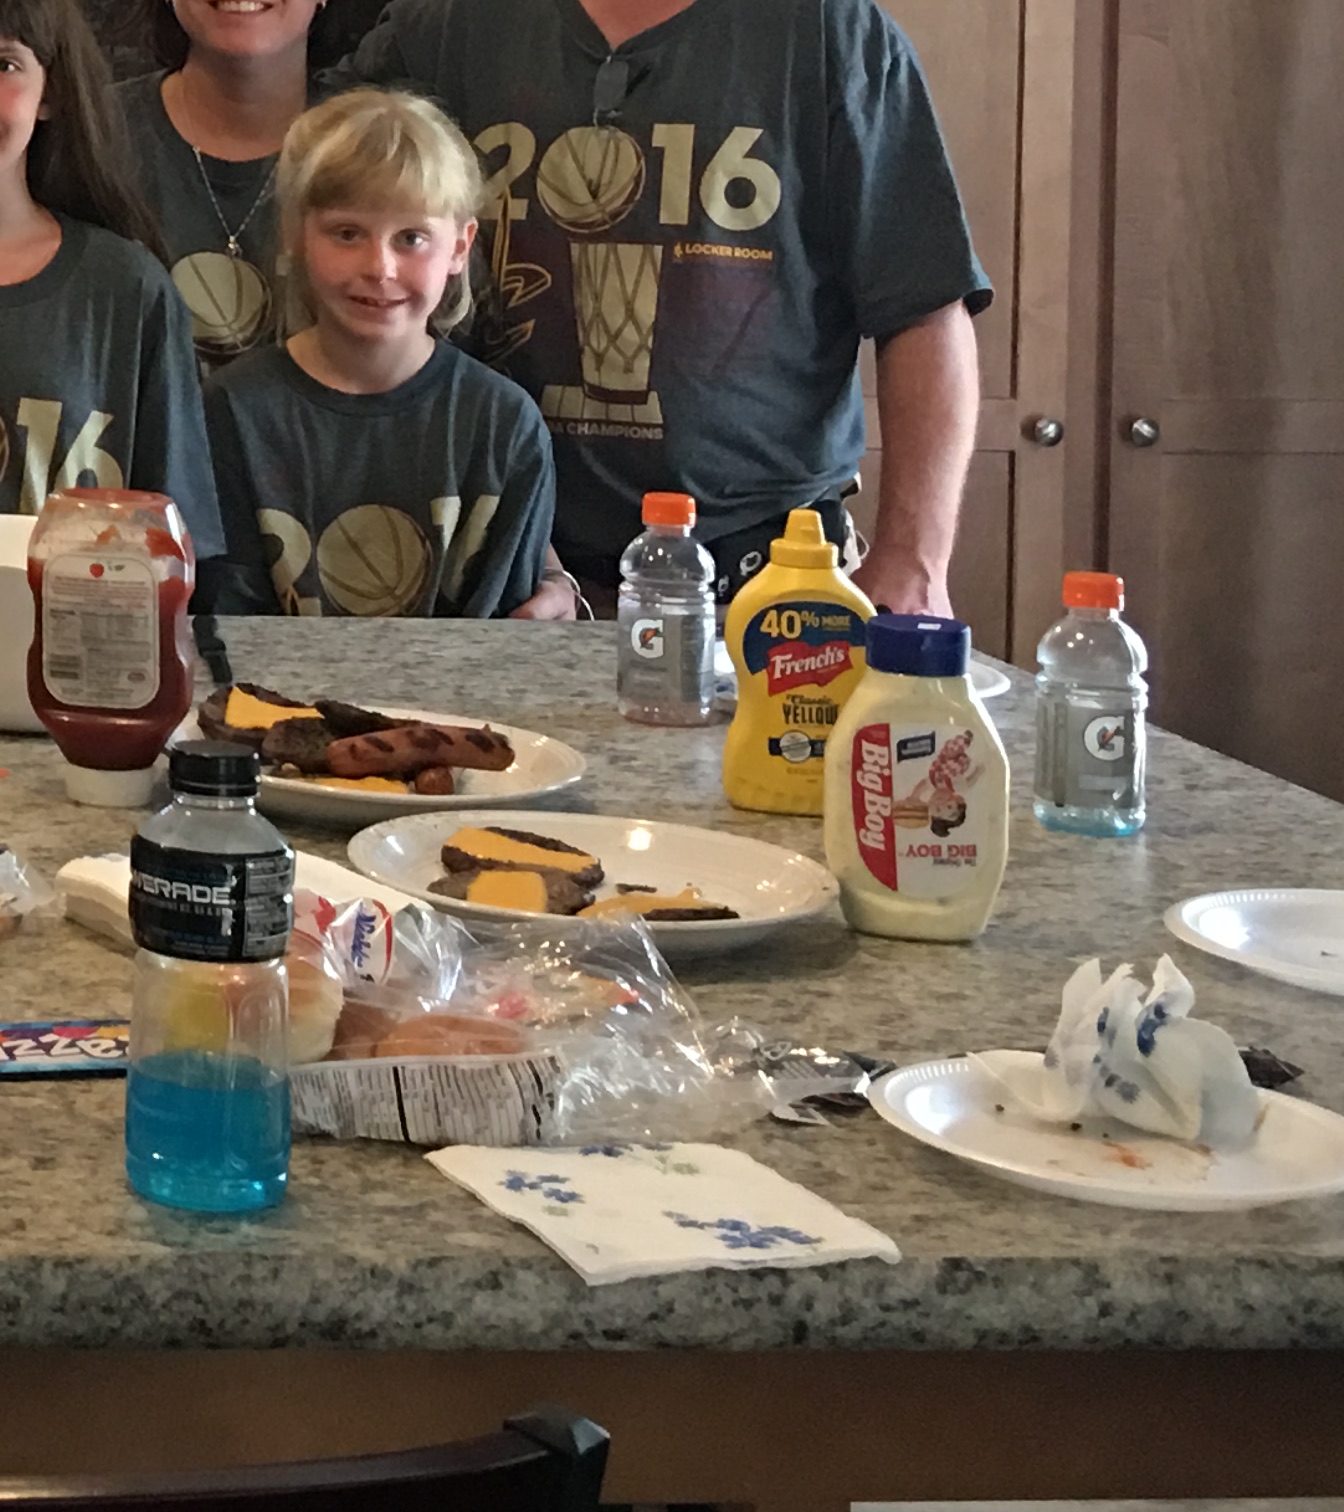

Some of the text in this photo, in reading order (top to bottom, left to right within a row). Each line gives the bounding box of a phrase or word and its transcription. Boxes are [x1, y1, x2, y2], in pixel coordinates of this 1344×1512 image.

[566, 421, 664, 440] CHAMPIONS
[631, 619, 664, 659] G
[759, 609, 820, 640] 40%
[770, 645, 846, 680] French's
[1083, 715, 1126, 761] G
[856, 739, 892, 851] Big Boy
[906, 844, 977, 858] BIG BOY
